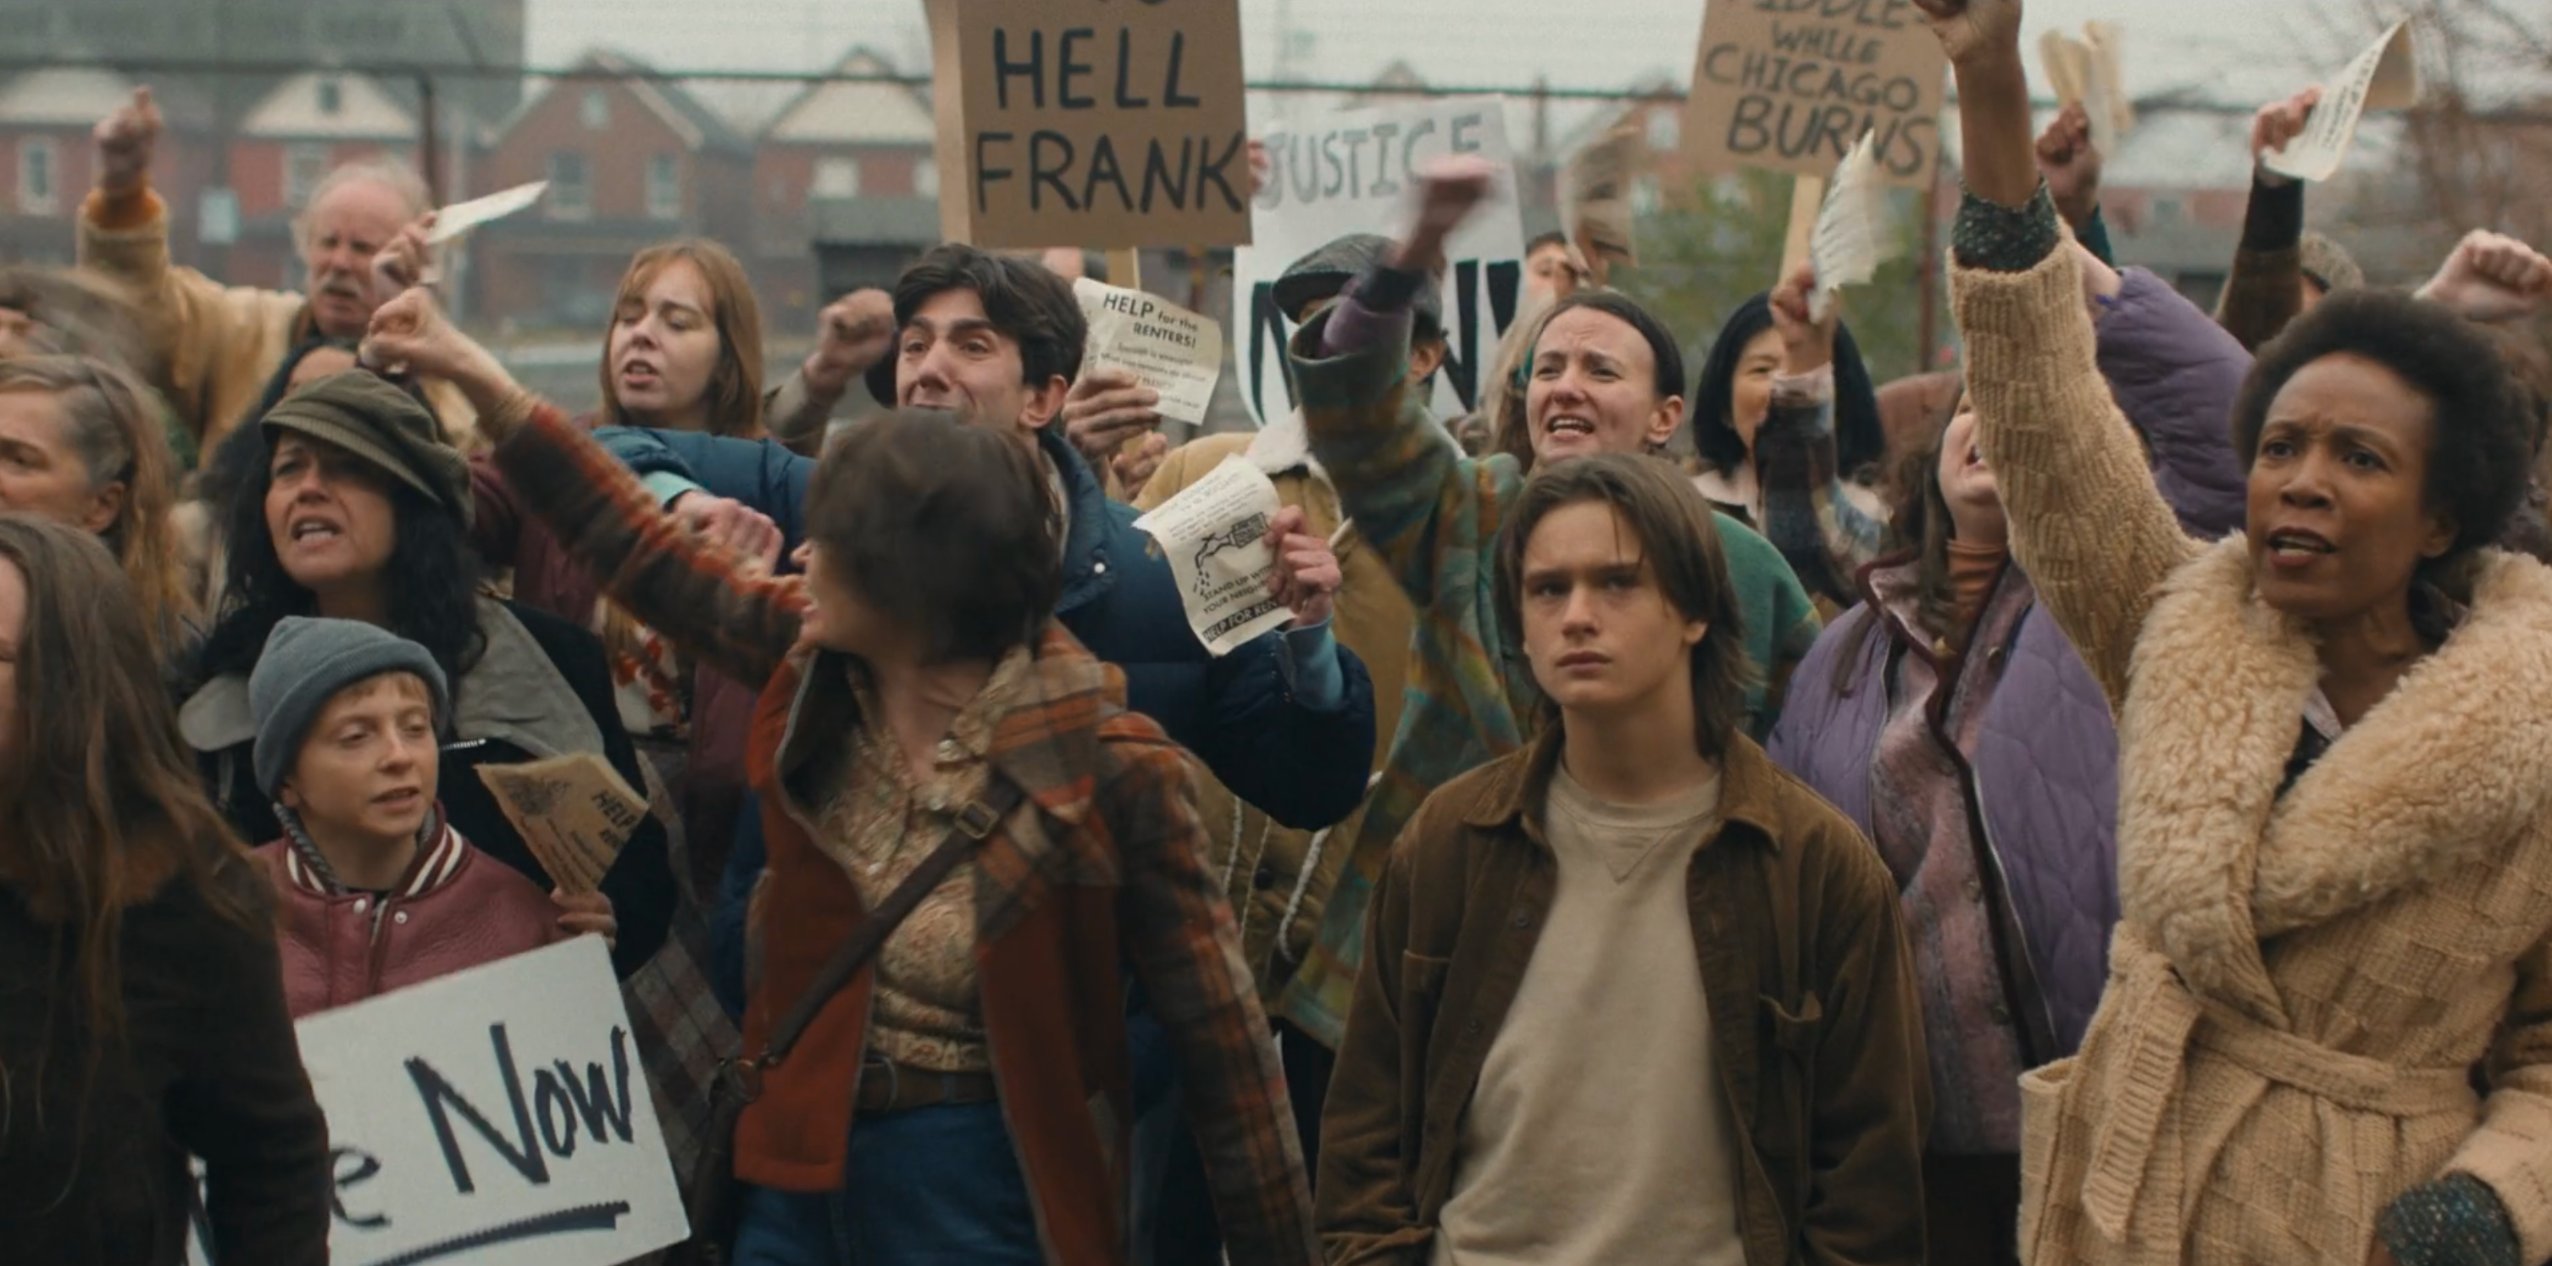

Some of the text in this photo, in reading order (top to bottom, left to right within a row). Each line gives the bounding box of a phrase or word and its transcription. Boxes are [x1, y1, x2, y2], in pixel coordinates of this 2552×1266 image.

[993, 28, 1200, 110] HELL
[1771, 20, 1883, 63] WHILE
[1704, 43, 1918, 112] CHICAGO
[1727, 94, 1937, 177] BURNS
[976, 129, 1245, 213] FRANK
[1103, 293, 1198, 331] HELP for the
[1133, 322, 1196, 349] RENTERS!
[1228, 608, 1253, 628] FOR
[591, 789, 637, 828] HELP
[404, 1021, 633, 1194] Now
